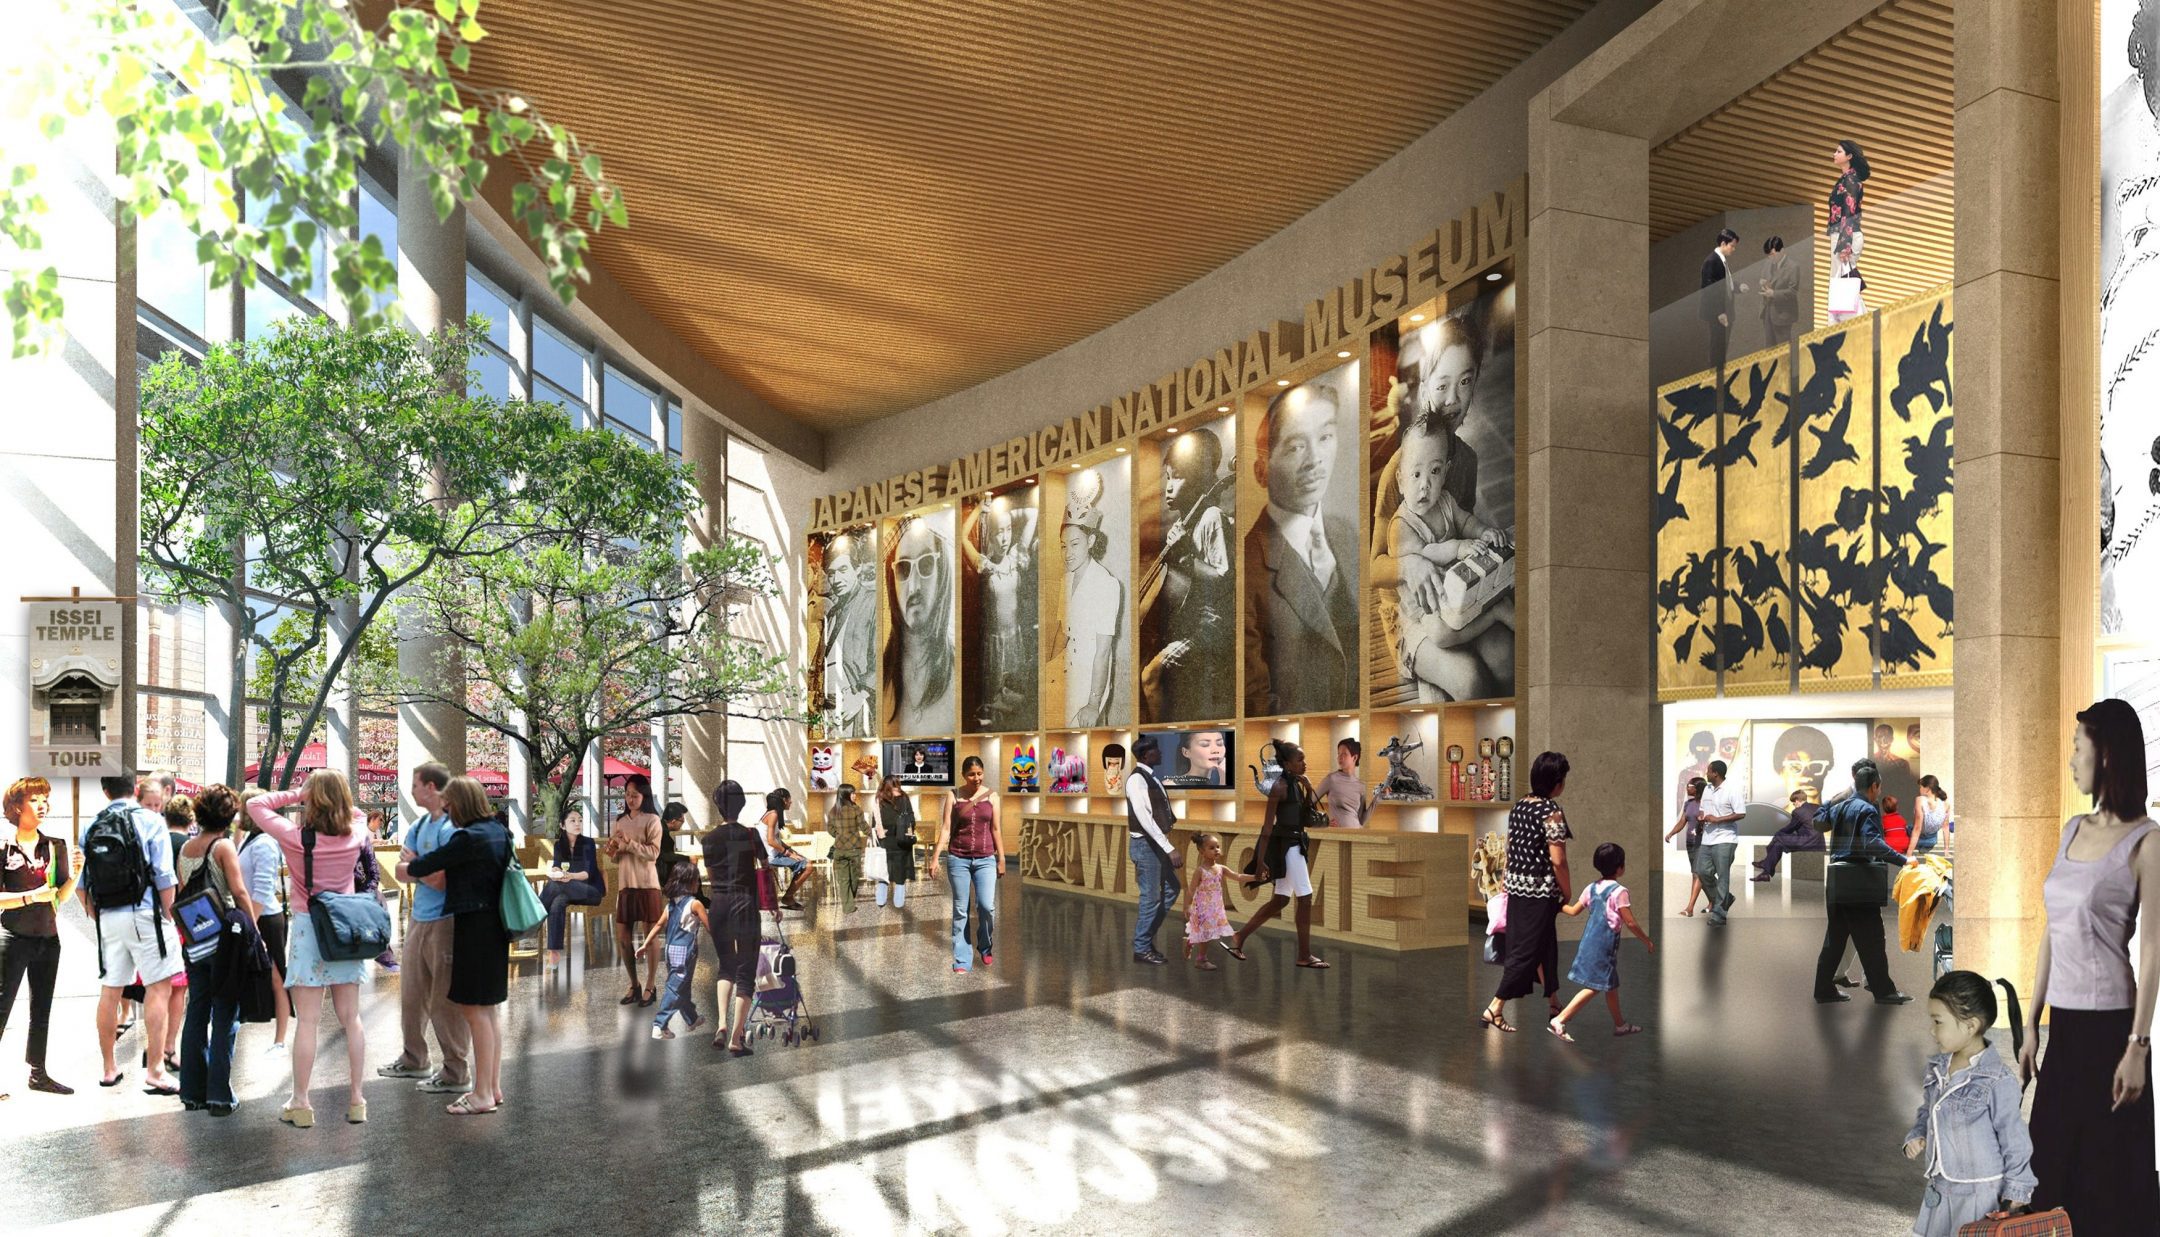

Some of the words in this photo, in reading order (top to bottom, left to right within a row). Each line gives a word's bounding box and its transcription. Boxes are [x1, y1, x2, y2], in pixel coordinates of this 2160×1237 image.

[806, 465, 948, 530] JAPANESE
[946, 404, 1102, 499] AMERICAN
[1111, 319, 1293, 443] NATIONAL
[1303, 175, 1527, 355] MUSEUM
[50, 609, 101, 625] ISSEI
[36, 626, 115, 641] TEMPLE
[49, 751, 102, 767] TOUR
[1077, 822, 1400, 941] WOME
